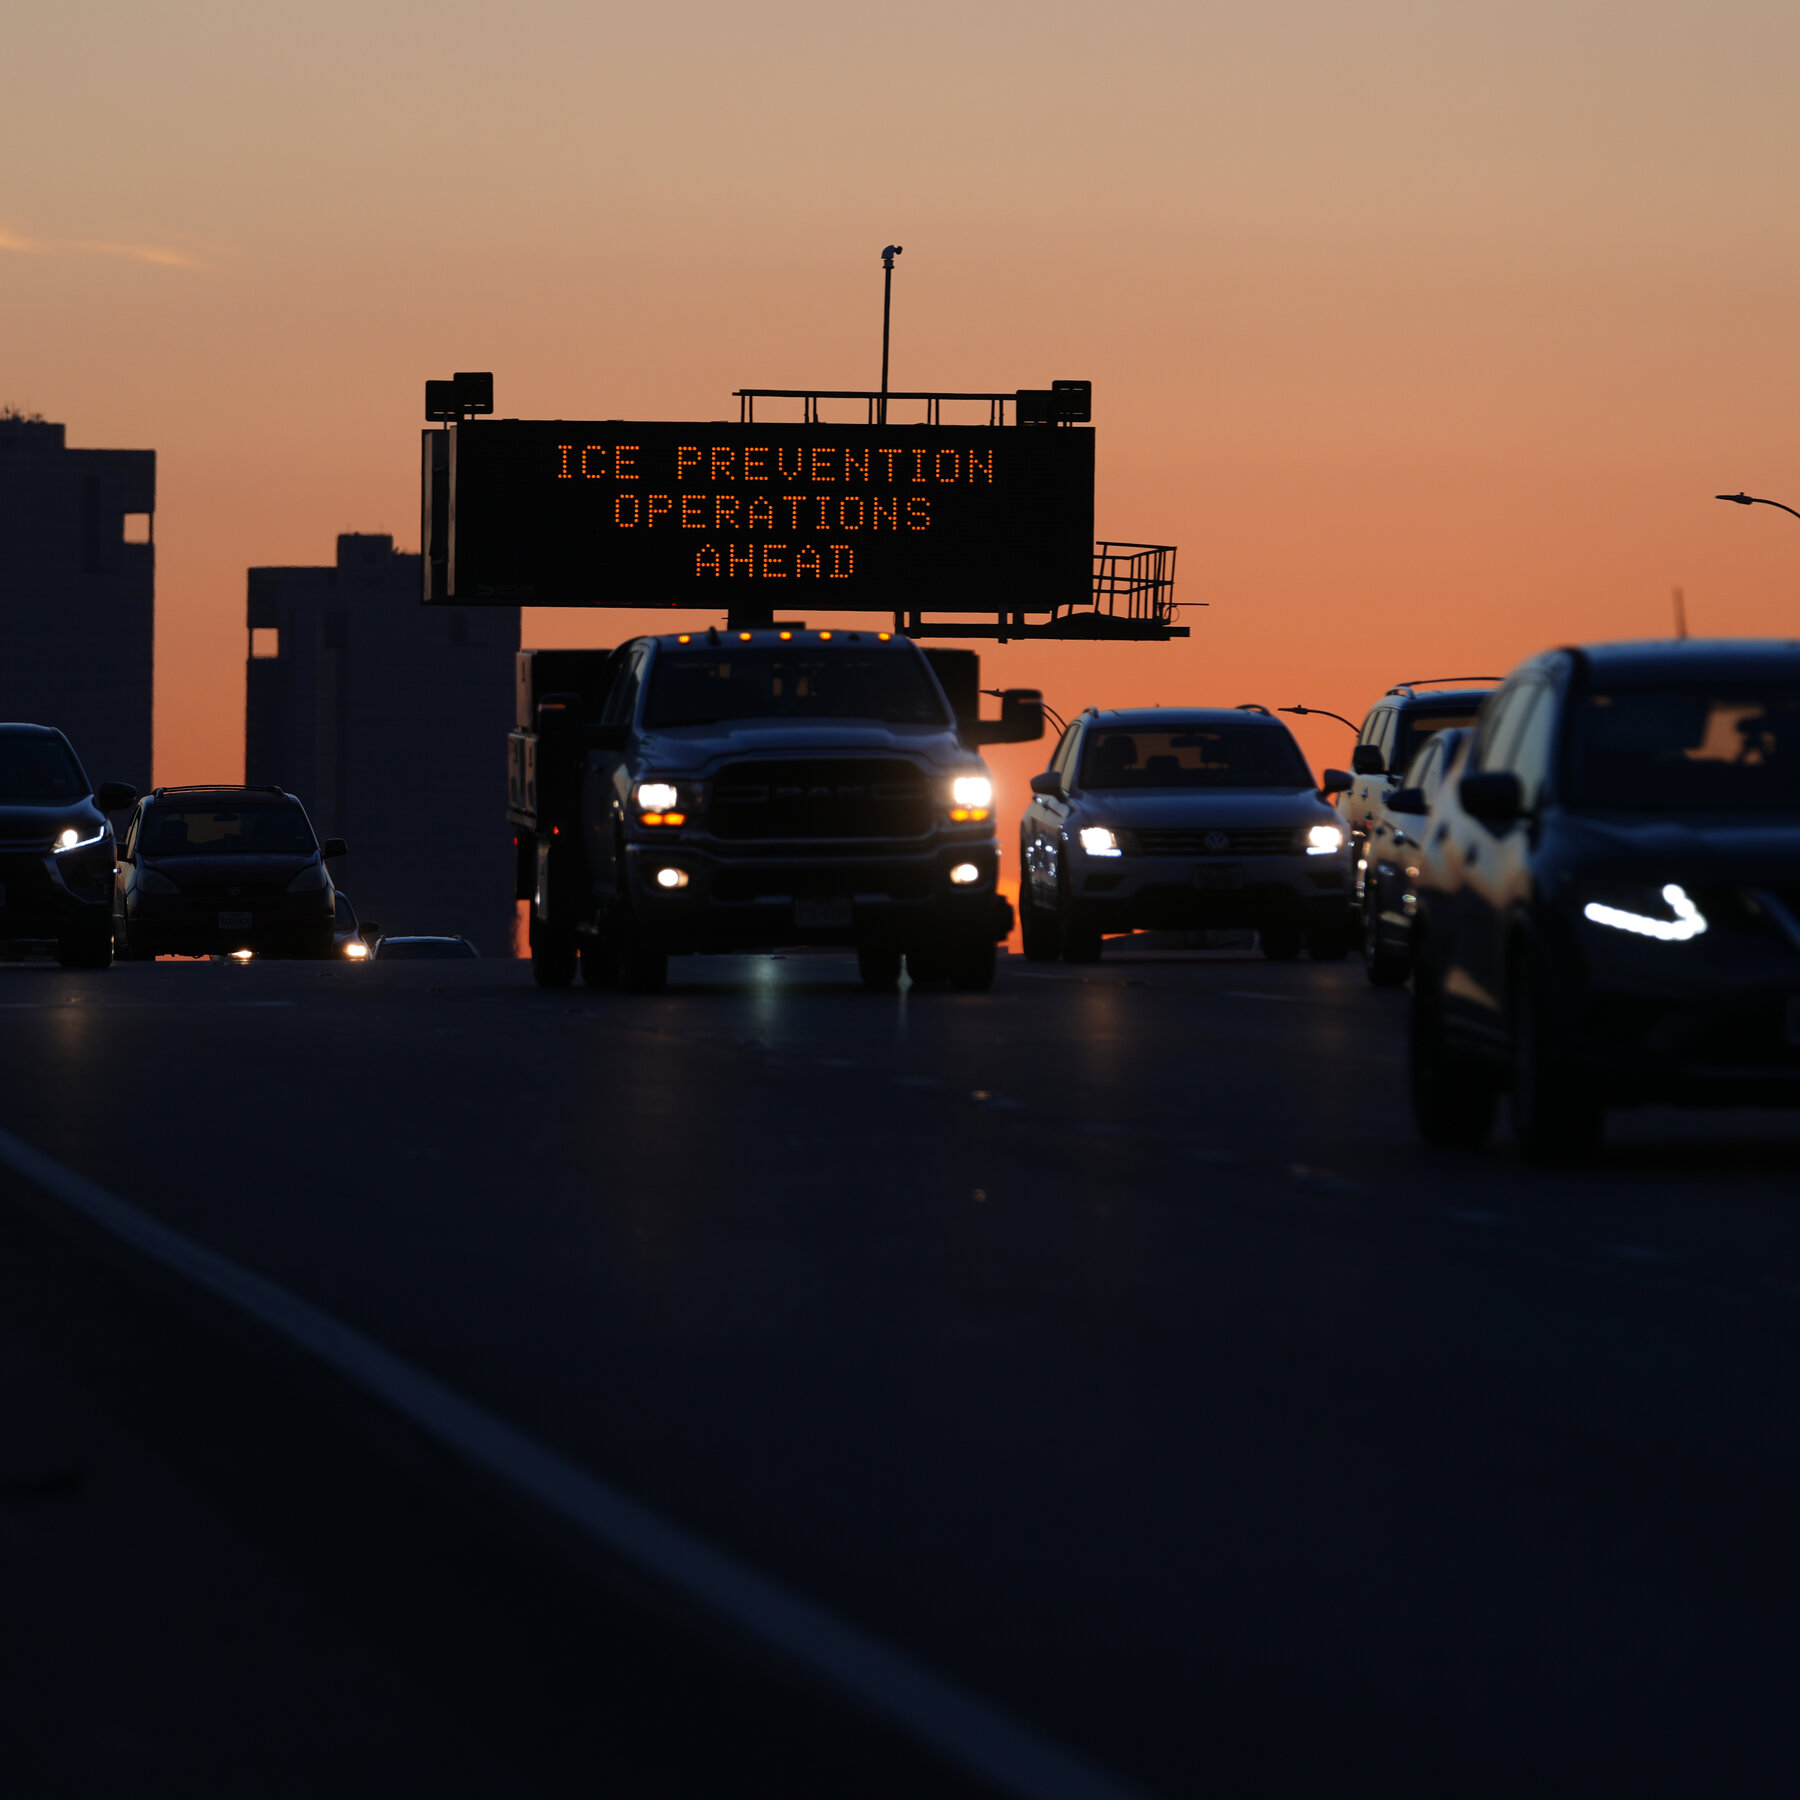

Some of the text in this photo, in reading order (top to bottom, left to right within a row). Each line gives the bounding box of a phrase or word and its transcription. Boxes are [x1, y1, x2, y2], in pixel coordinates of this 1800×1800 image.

[556, 444, 994, 484] ICE PREVENTION
[613, 493, 933, 531] OPERATIONS
[695, 543, 855, 579] AHEAD
